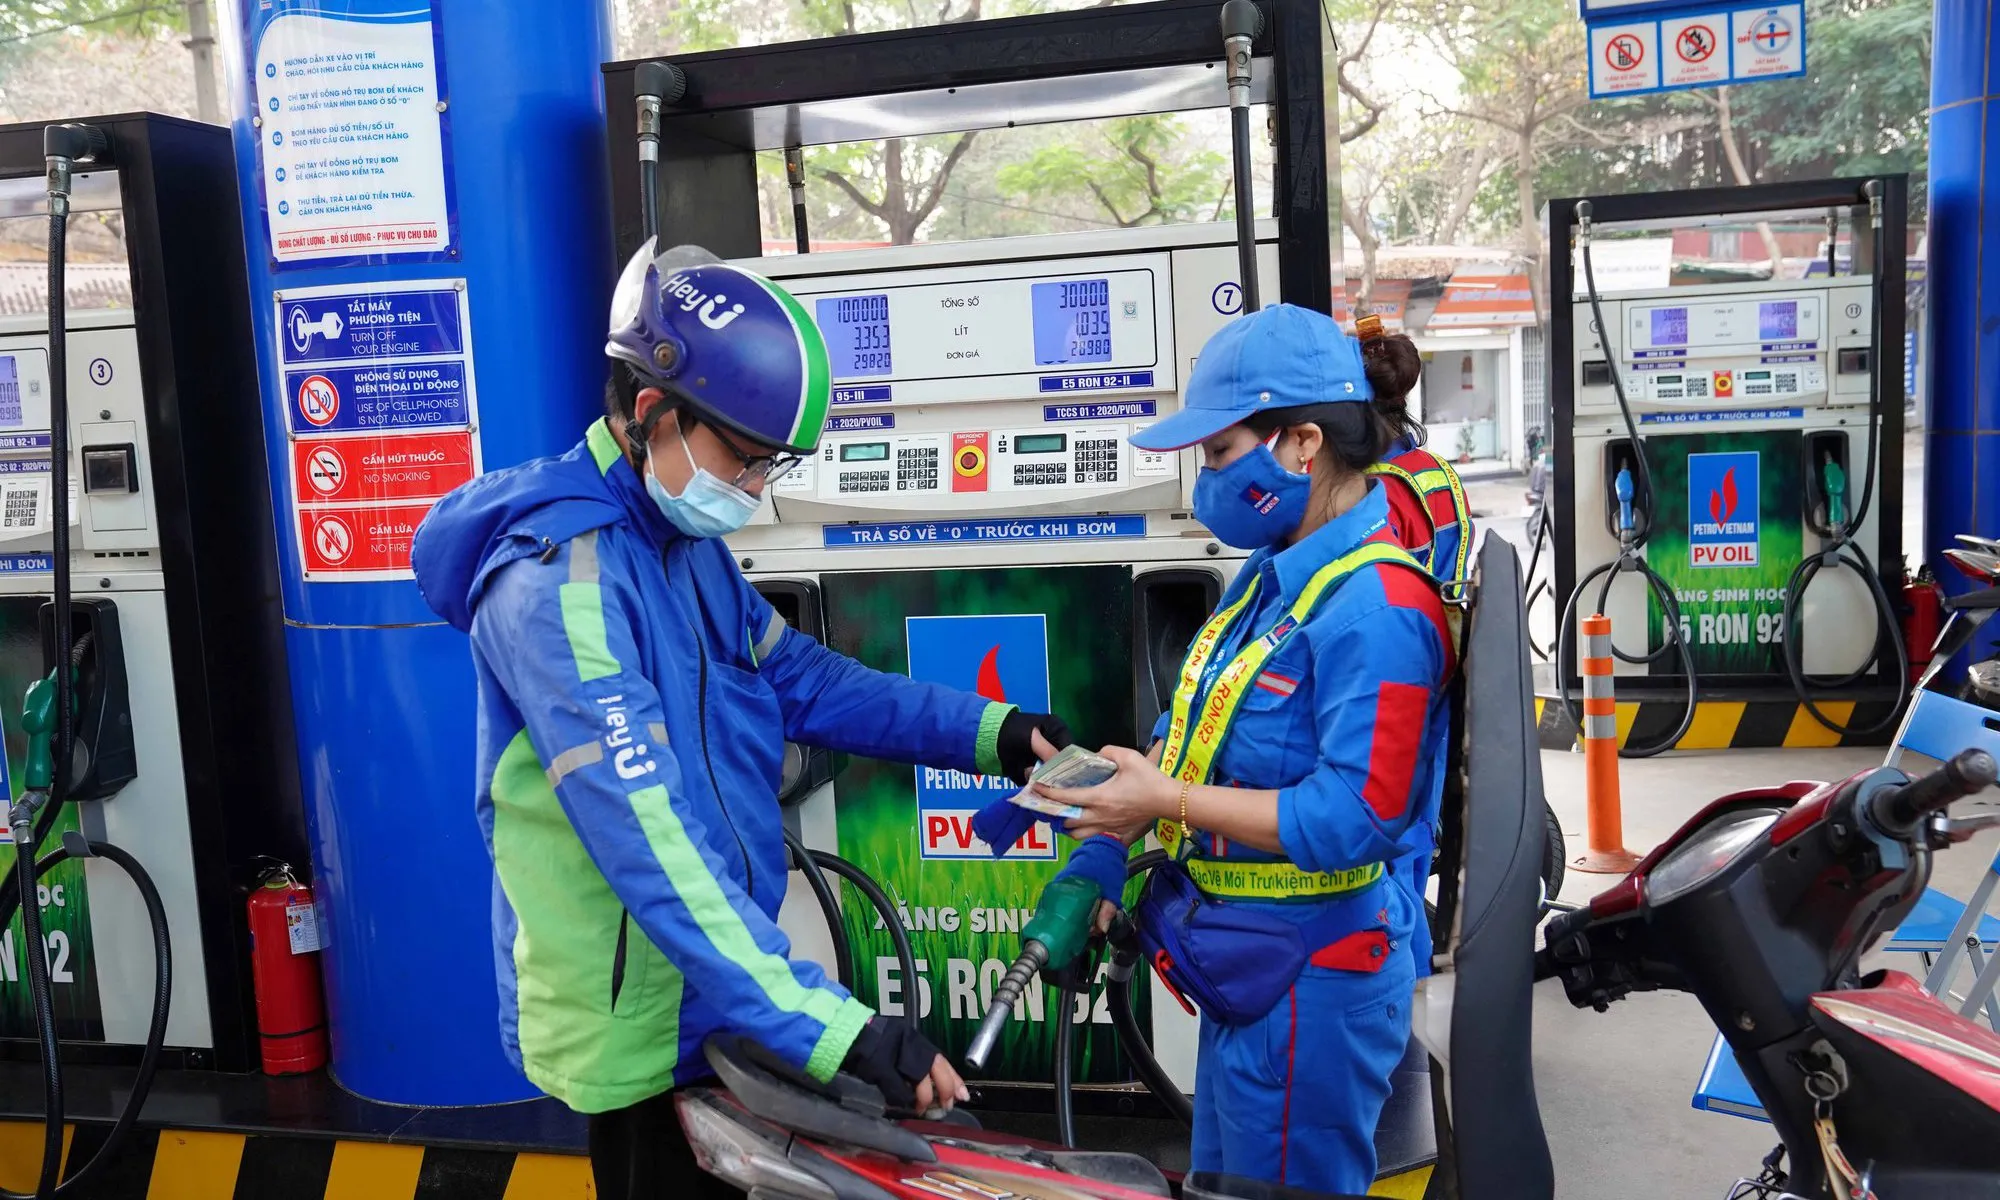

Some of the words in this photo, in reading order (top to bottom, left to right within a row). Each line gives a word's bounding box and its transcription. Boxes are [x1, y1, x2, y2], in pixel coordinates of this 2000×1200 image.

[941, 297, 965, 308] TỔNG
[967, 295, 980, 307] SỐ
[1059, 281, 1108, 309] 30000
[1224, 289, 1234, 306] 7
[348, 301, 366, 313] TẮT
[368, 299, 392, 312] MÁY
[837, 296, 888, 324] 100000
[349, 313, 395, 325] PHƯƠNG
[396, 311, 421, 325] TIỆN
[350, 332, 376, 342] TURN
[377, 330, 396, 341] OFF
[954, 324, 969, 336] LÍT
[352, 344, 379, 354] YOUR
[381, 342, 420, 353] ENGINE
[946, 350, 964, 360] ĐƠN
[965, 348, 980, 359] GIÁ
[11, 357, 18, 378] 0
[854, 352, 891, 370] 29820
[97, 364, 105, 379] 3
[354, 371, 391, 383] KHÔNG
[393, 368, 408, 382] SỬ
[409, 369, 439, 381] DỤNG
[355, 382, 377, 395] ĐIỆN
[378, 381, 410, 394] THOẠI
[413, 381, 424, 391] DI
[426, 379, 460, 391] ĐỘNG
[1062, 379, 1076, 390] E5
[1078, 377, 1101, 389] RON
[1103, 375, 1131, 387] 92-II
[836, 390, 865, 402] 95-III
[357, 403, 374, 413] USE
[376, 402, 391, 413] OF
[392, 398, 459, 412] CELLPHONES
[1055, 407, 1078, 419] TCCS
[1079, 407, 1090, 417] 01
[1097, 405, 1144, 417] 2020/PVOIL
[358, 415, 366, 425] IS
[367, 414, 389, 425] NOT
[391, 411, 441, 423] ALLOWED
[839, 416, 884, 428] 2020/PVOIL
[16, 437, 37, 446] 92-II
[362, 452, 385, 465] CẤM
[387, 451, 407, 464] HÚT
[408, 449, 445, 463] THUỐC
[22, 461, 52, 471] 2020/PVO
[364, 473, 379, 484] NO
[382, 471, 431, 483] SMOKING
[369, 522, 392, 536] CẤM
[394, 521, 414, 535] LỬA
[851, 527, 884, 543] TRẢ
[888, 525, 911, 541] SỐ
[916, 524, 937, 540] VỀ
[975, 521, 1034, 538] TRƯỚC
[1040, 522, 1068, 536] KHI
[1077, 521, 1116, 536] BƠM
[1693, 522, 1755, 536] PETROVIETNAM
[370, 543, 386, 554] NO
[388, 541, 409, 553] FIRE
[1693, 547, 1719, 562] PV
[1722, 546, 1754, 562] OIL
[18, 558, 47, 570] BƠM
[1674, 586, 1709, 602] ĂNG
[1713, 588, 1750, 602] SINH
[1700, 613, 1749, 644] RON
[1756, 612, 1784, 644] 92
[1191, 629, 1217, 667] RON
[1207, 682, 1232, 724] RON
[1173, 717, 1184, 741] E5
[1197, 721, 1215, 745] 92
[1164, 745, 1179, 771] RO
[1182, 760, 1200, 784] E5
[927, 816, 974, 849] PV
[1224, 872, 1245, 888] Môi
[36, 884, 65, 913] ỌC
[947, 958, 1045, 1022] RON
